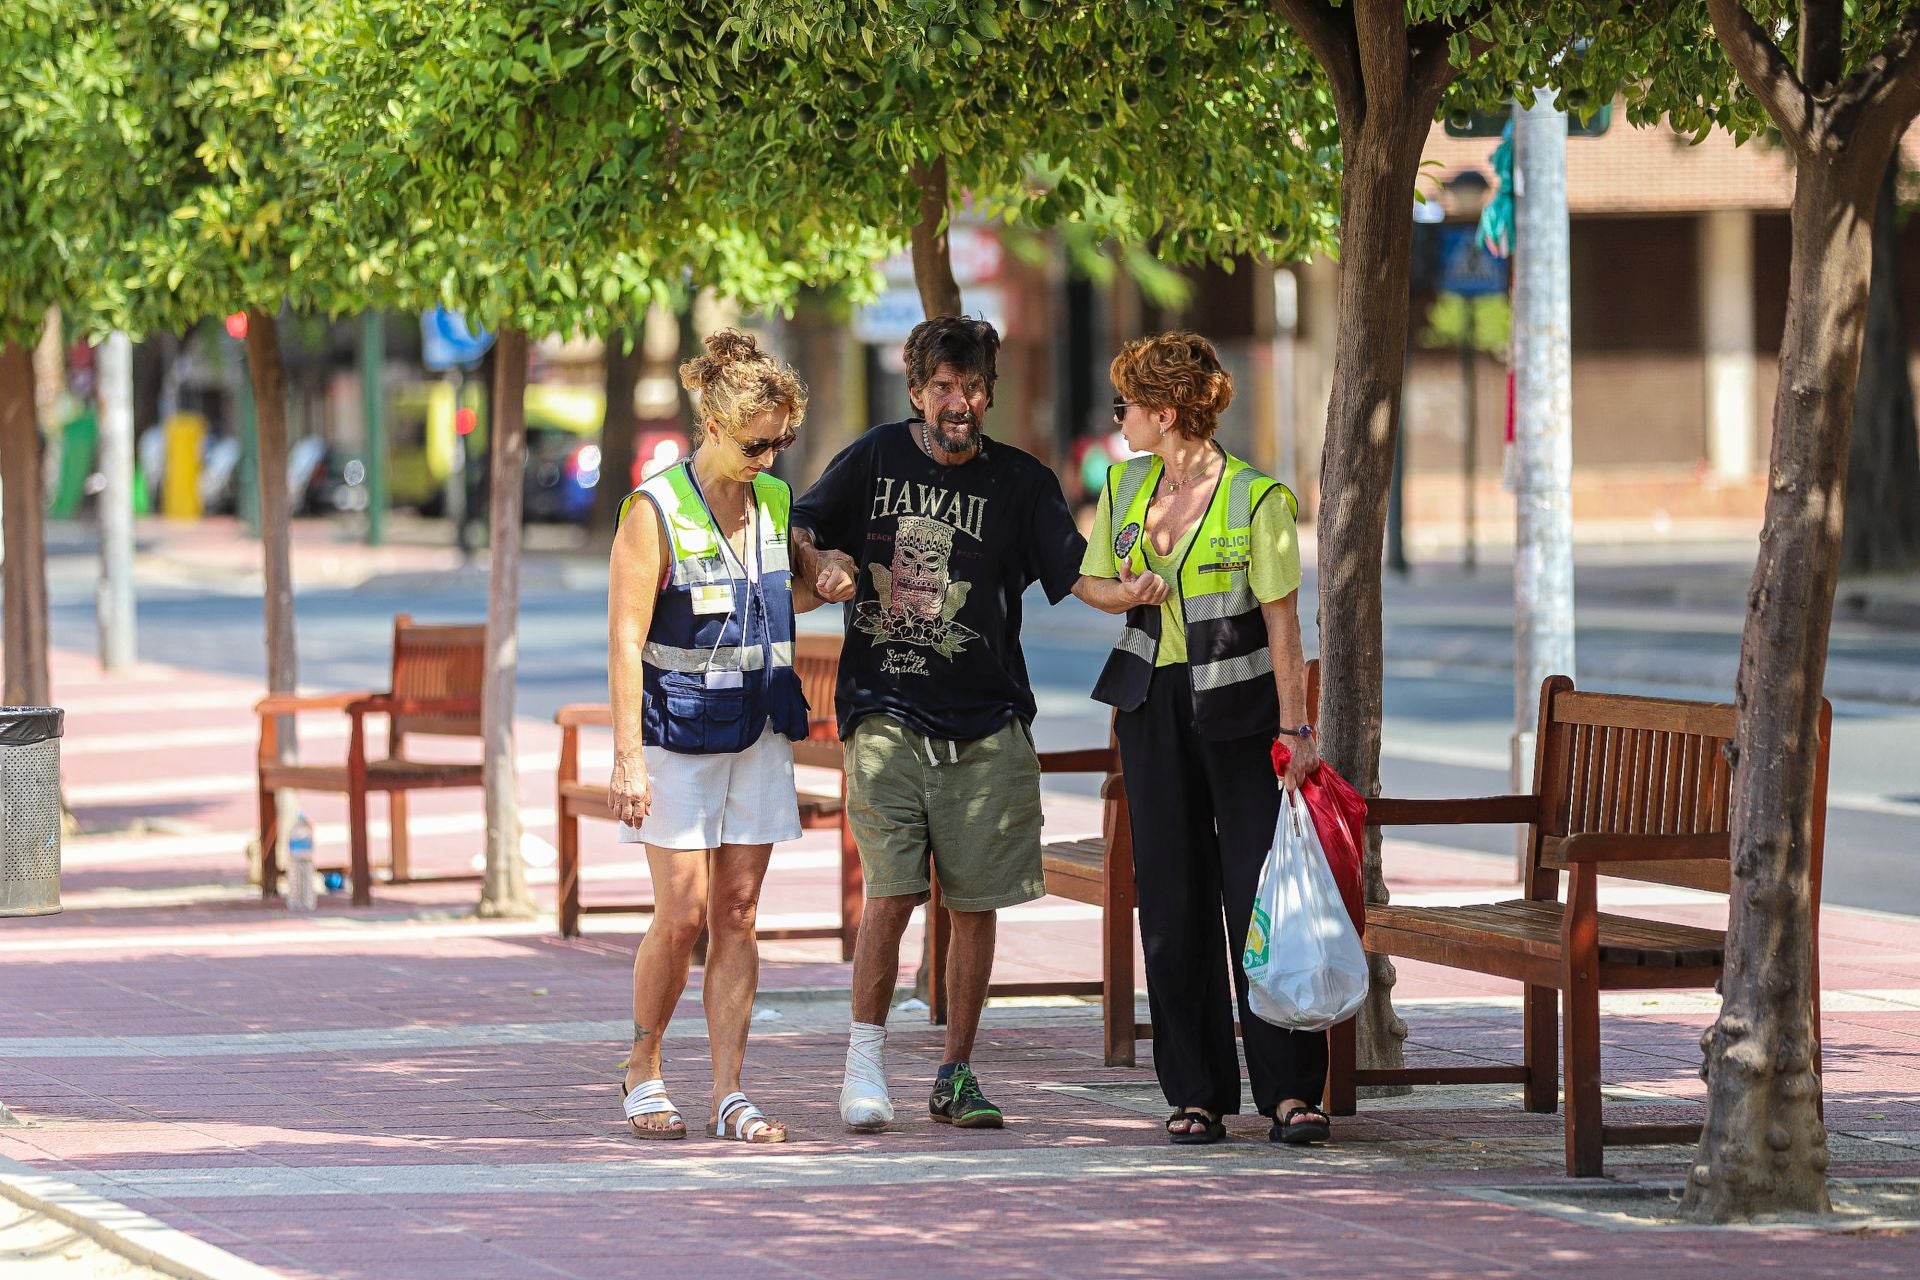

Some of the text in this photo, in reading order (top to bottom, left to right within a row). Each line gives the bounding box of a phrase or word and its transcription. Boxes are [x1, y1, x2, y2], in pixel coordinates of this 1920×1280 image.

[870, 477, 988, 542] HAWAII
[866, 532, 892, 542] BEACH
[886, 648, 927, 668] Surfing
[880, 660, 931, 677] Paradise
